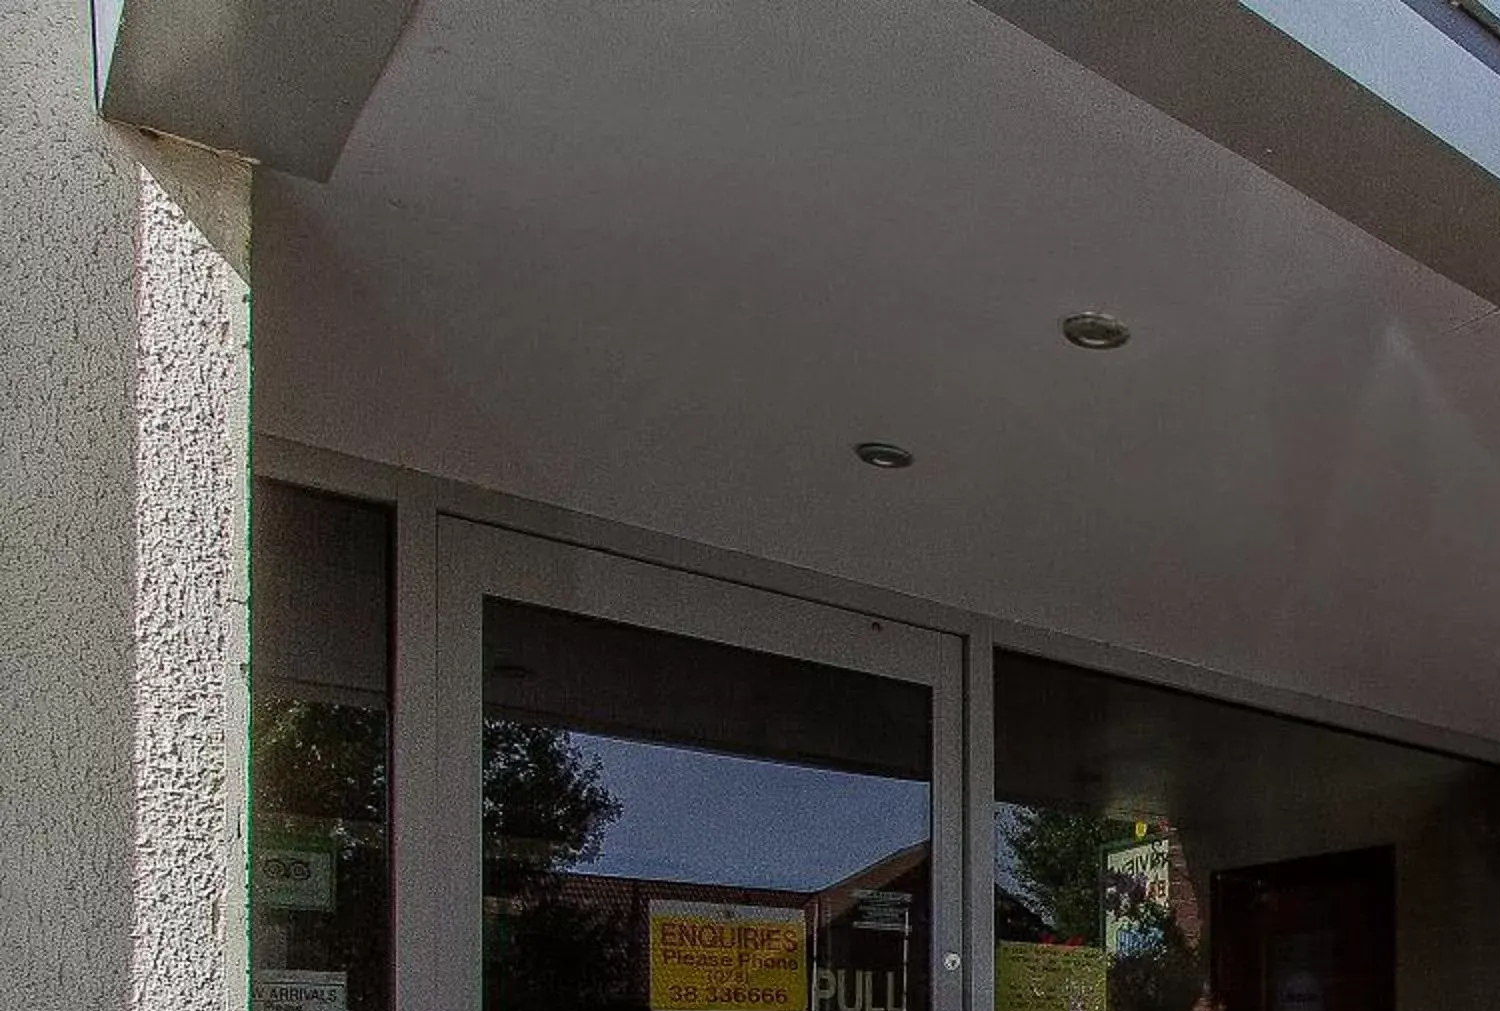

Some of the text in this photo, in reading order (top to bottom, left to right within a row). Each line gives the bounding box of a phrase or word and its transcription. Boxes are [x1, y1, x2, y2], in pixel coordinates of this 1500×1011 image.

[661, 922, 797, 952] ENQUIRIES
[663, 949, 797, 970] Please Phone
[269, 987, 336, 1002] ARRIVALS
[670, 986, 697, 1003] 38
